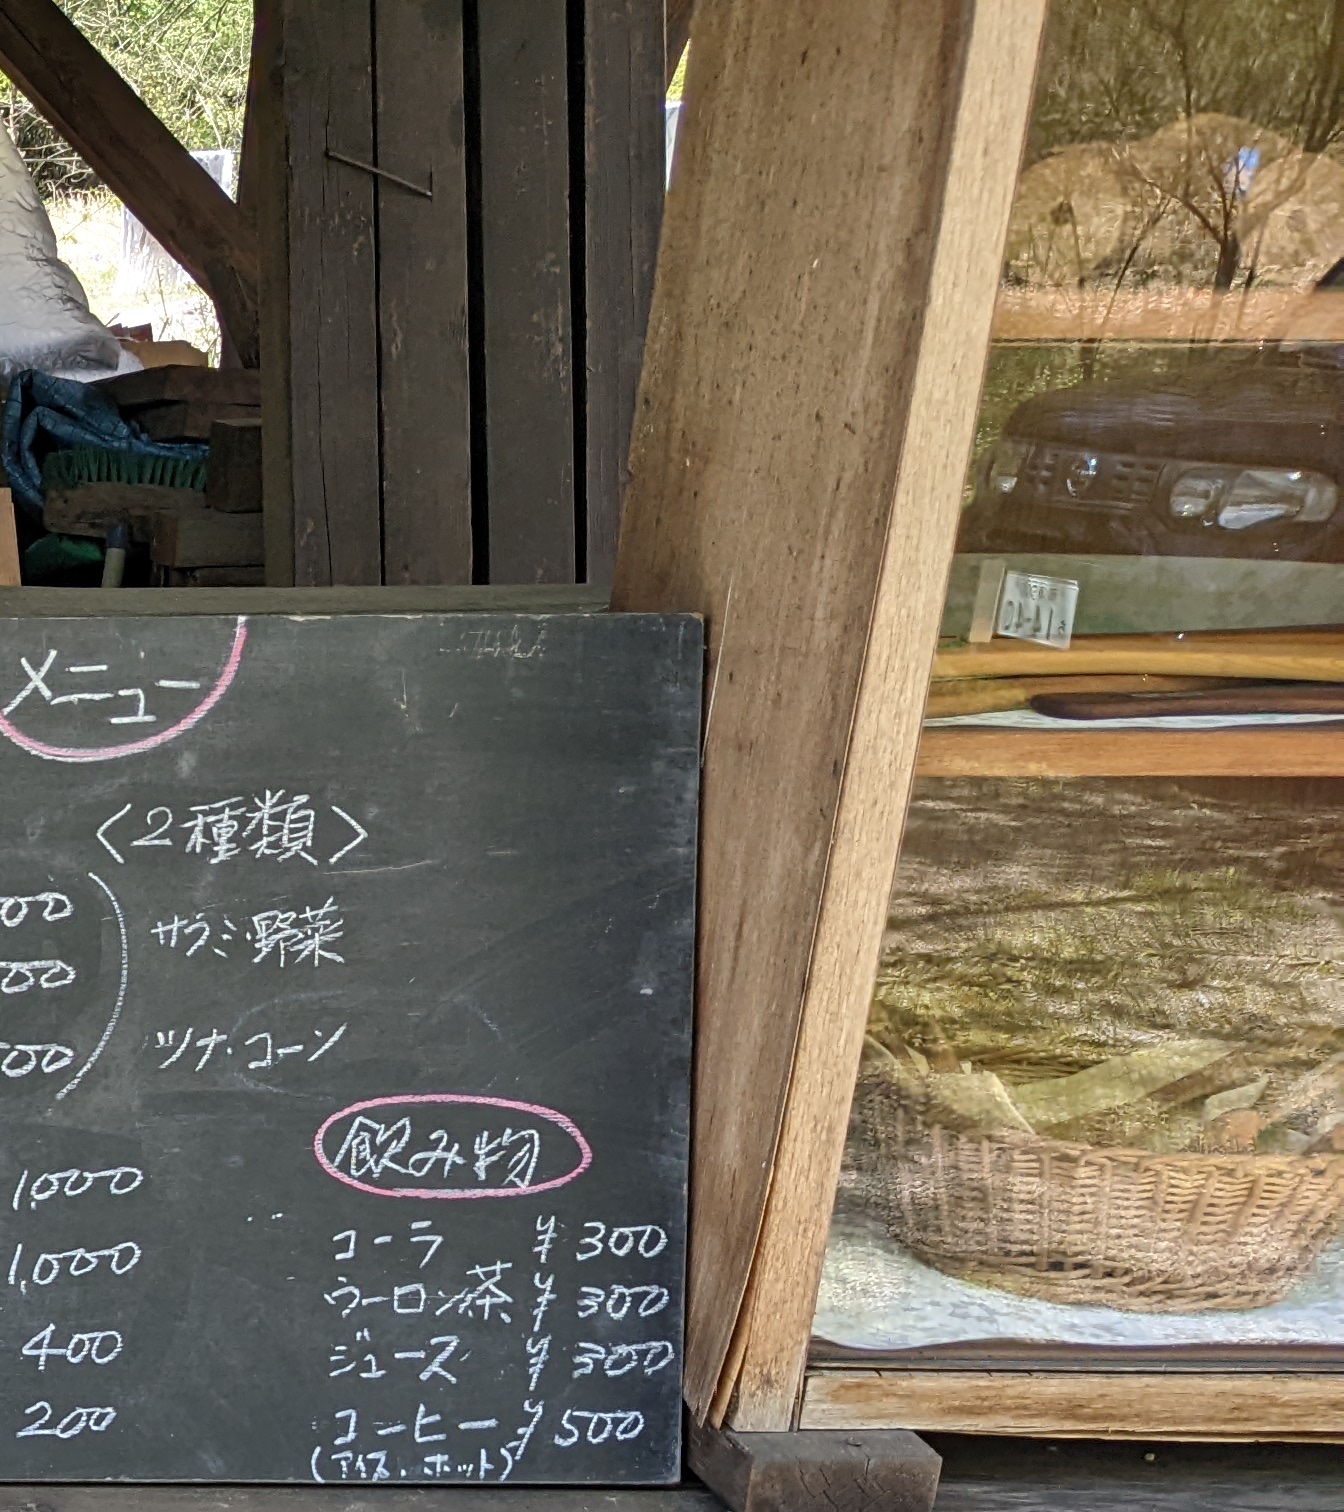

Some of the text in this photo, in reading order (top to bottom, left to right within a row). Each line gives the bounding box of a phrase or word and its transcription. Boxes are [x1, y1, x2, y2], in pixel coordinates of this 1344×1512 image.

[0, 648, 201, 724] メニュー
[332, 1116, 541, 1189] 飲み物
[332, 1220, 444, 1269] コーラ
[329, 1327, 460, 1385] ジュース
[333, 1403, 499, 1446] コーヒー
